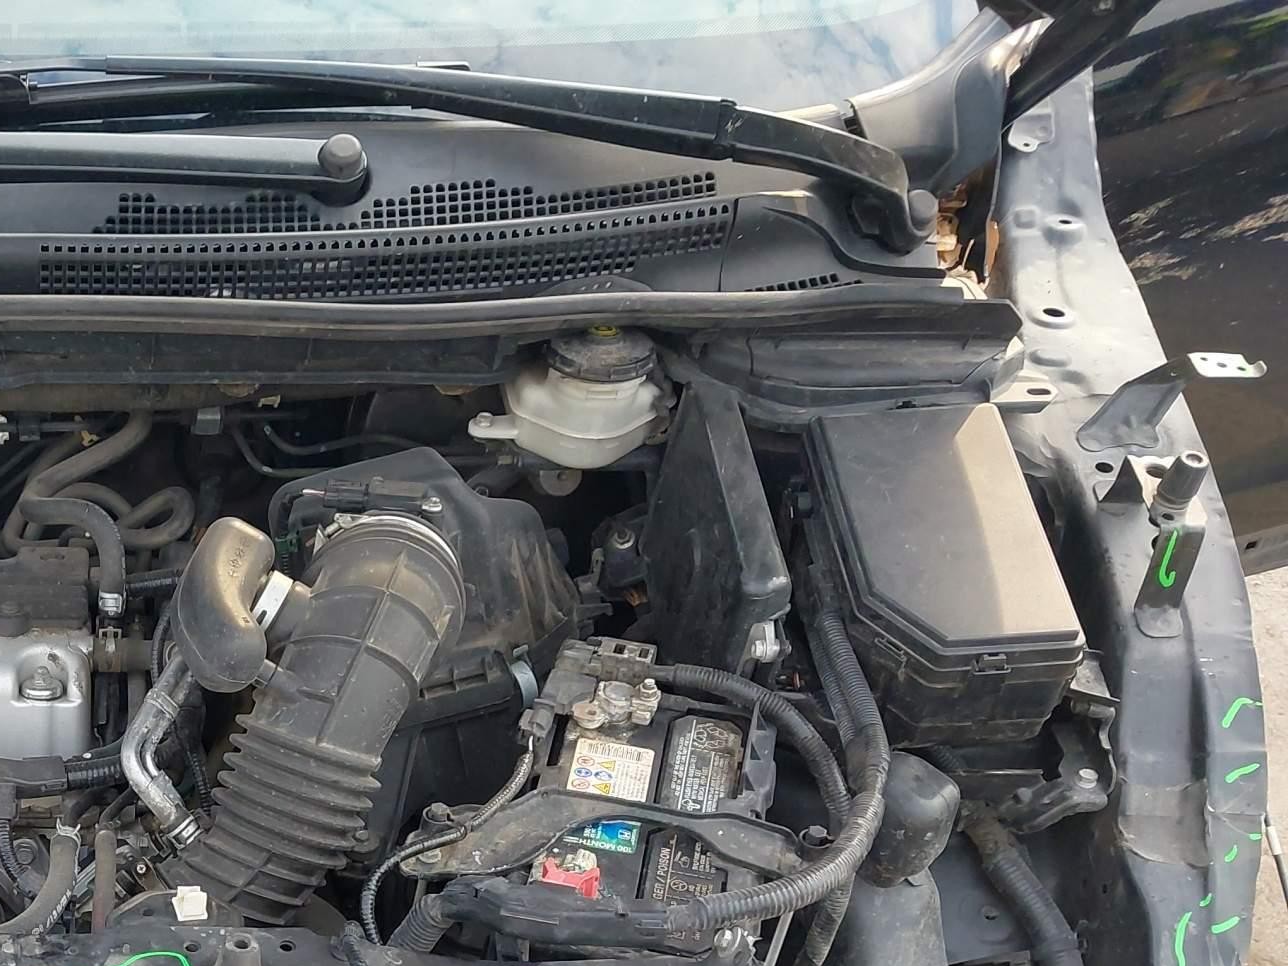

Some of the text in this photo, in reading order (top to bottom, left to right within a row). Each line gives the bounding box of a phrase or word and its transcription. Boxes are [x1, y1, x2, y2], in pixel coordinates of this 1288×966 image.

[578, 838, 633, 853] 100 MONTH
[656, 847, 671, 877] POISON
